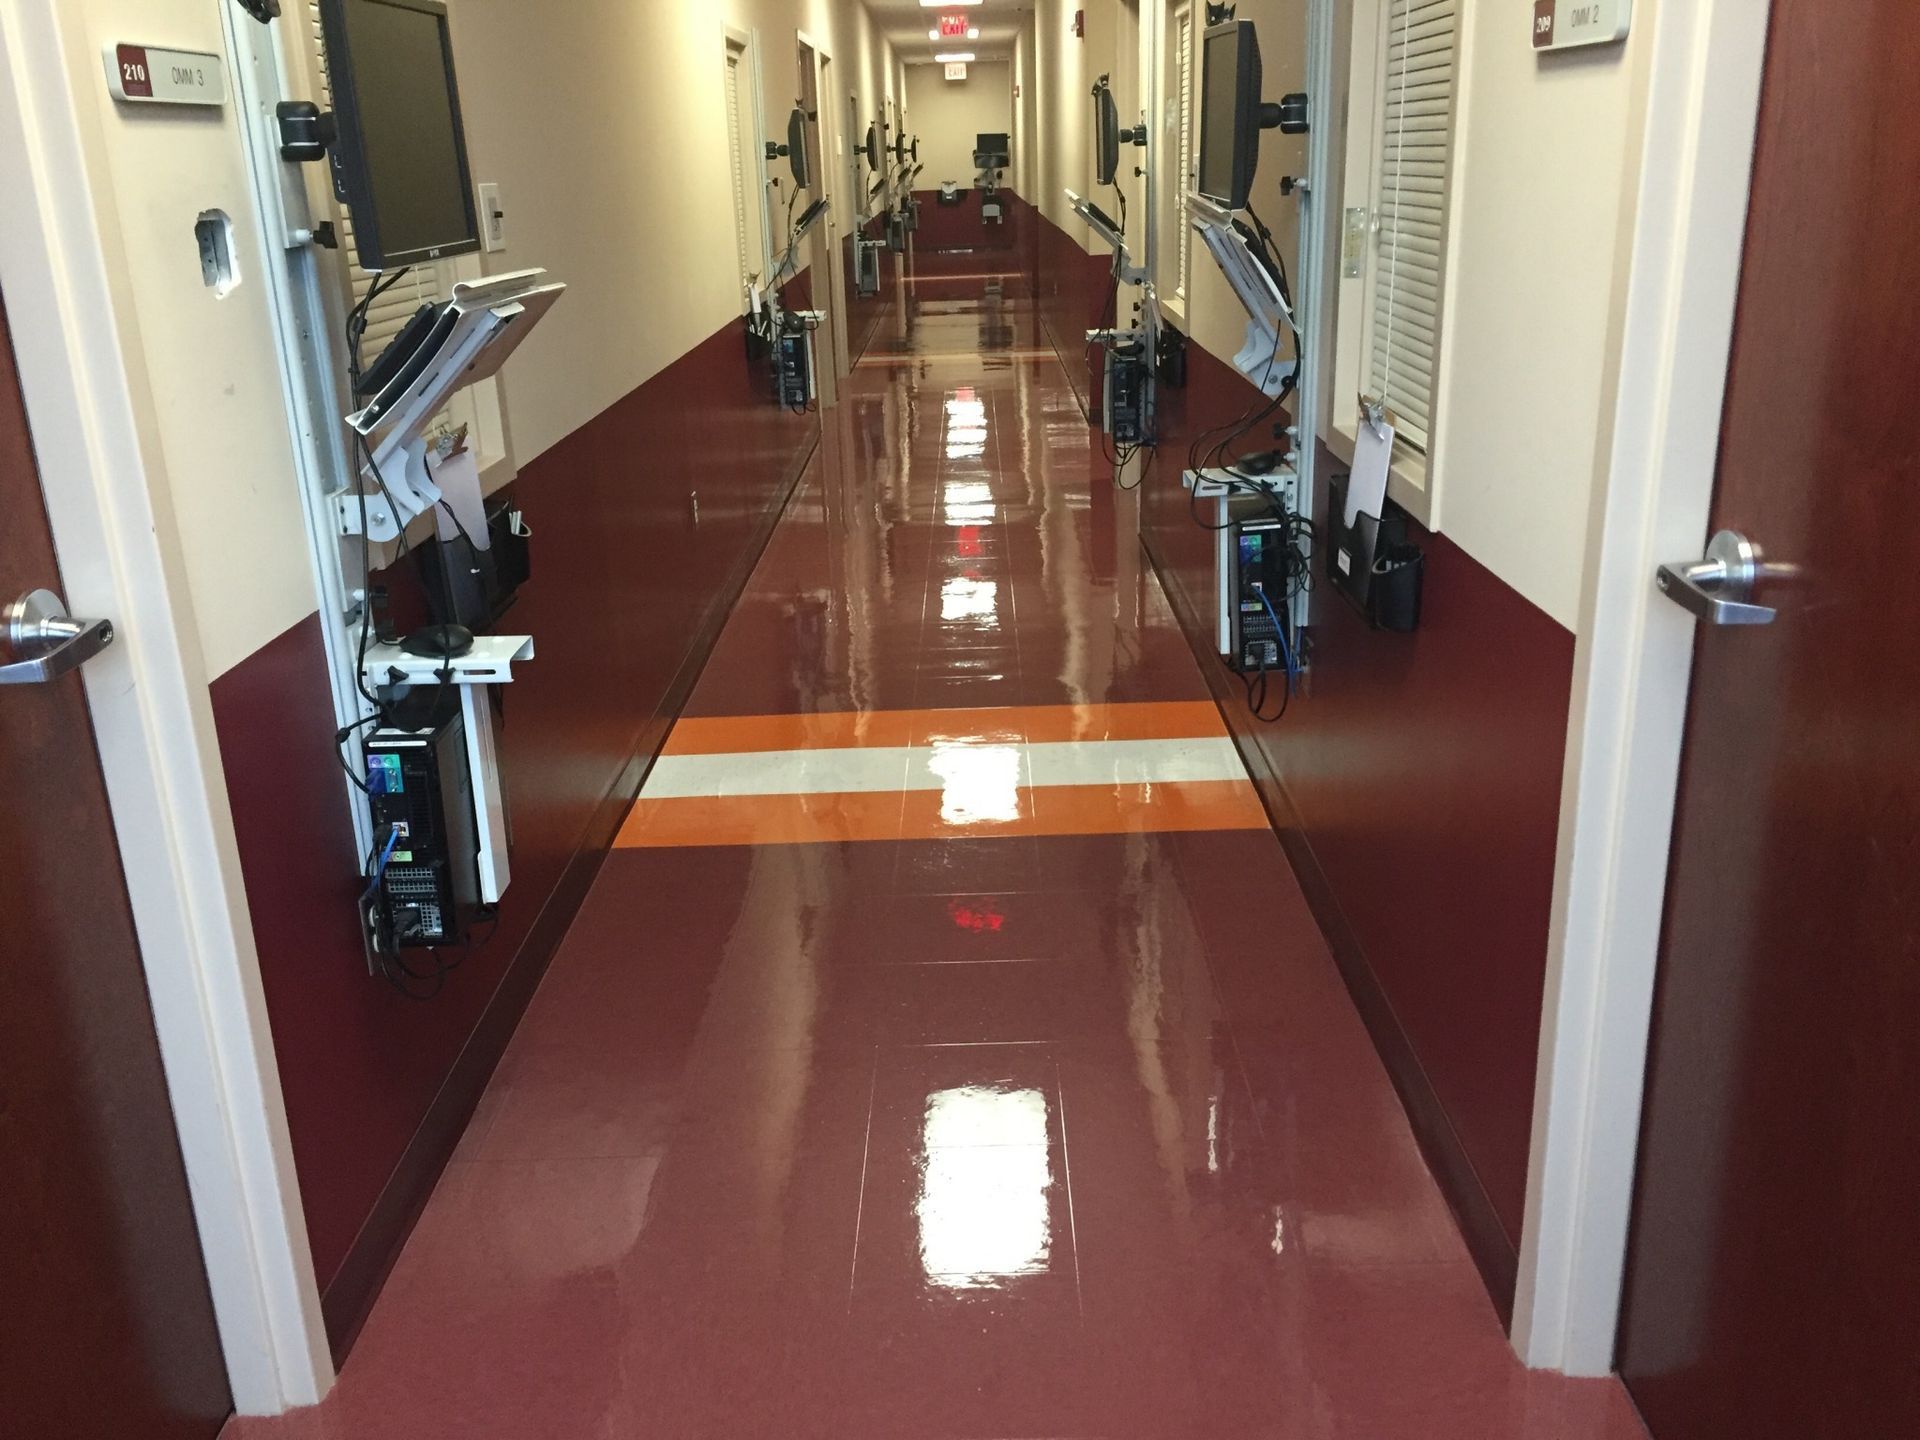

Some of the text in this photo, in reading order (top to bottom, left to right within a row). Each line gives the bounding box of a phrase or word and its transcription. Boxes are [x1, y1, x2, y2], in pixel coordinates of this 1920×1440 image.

[941, 16, 965, 35] EXIT
[1536, 15, 1551, 33] 209
[1593, 4, 1600, 24] 2
[123, 63, 145, 81] 210
[196, 69, 205, 87] 3
